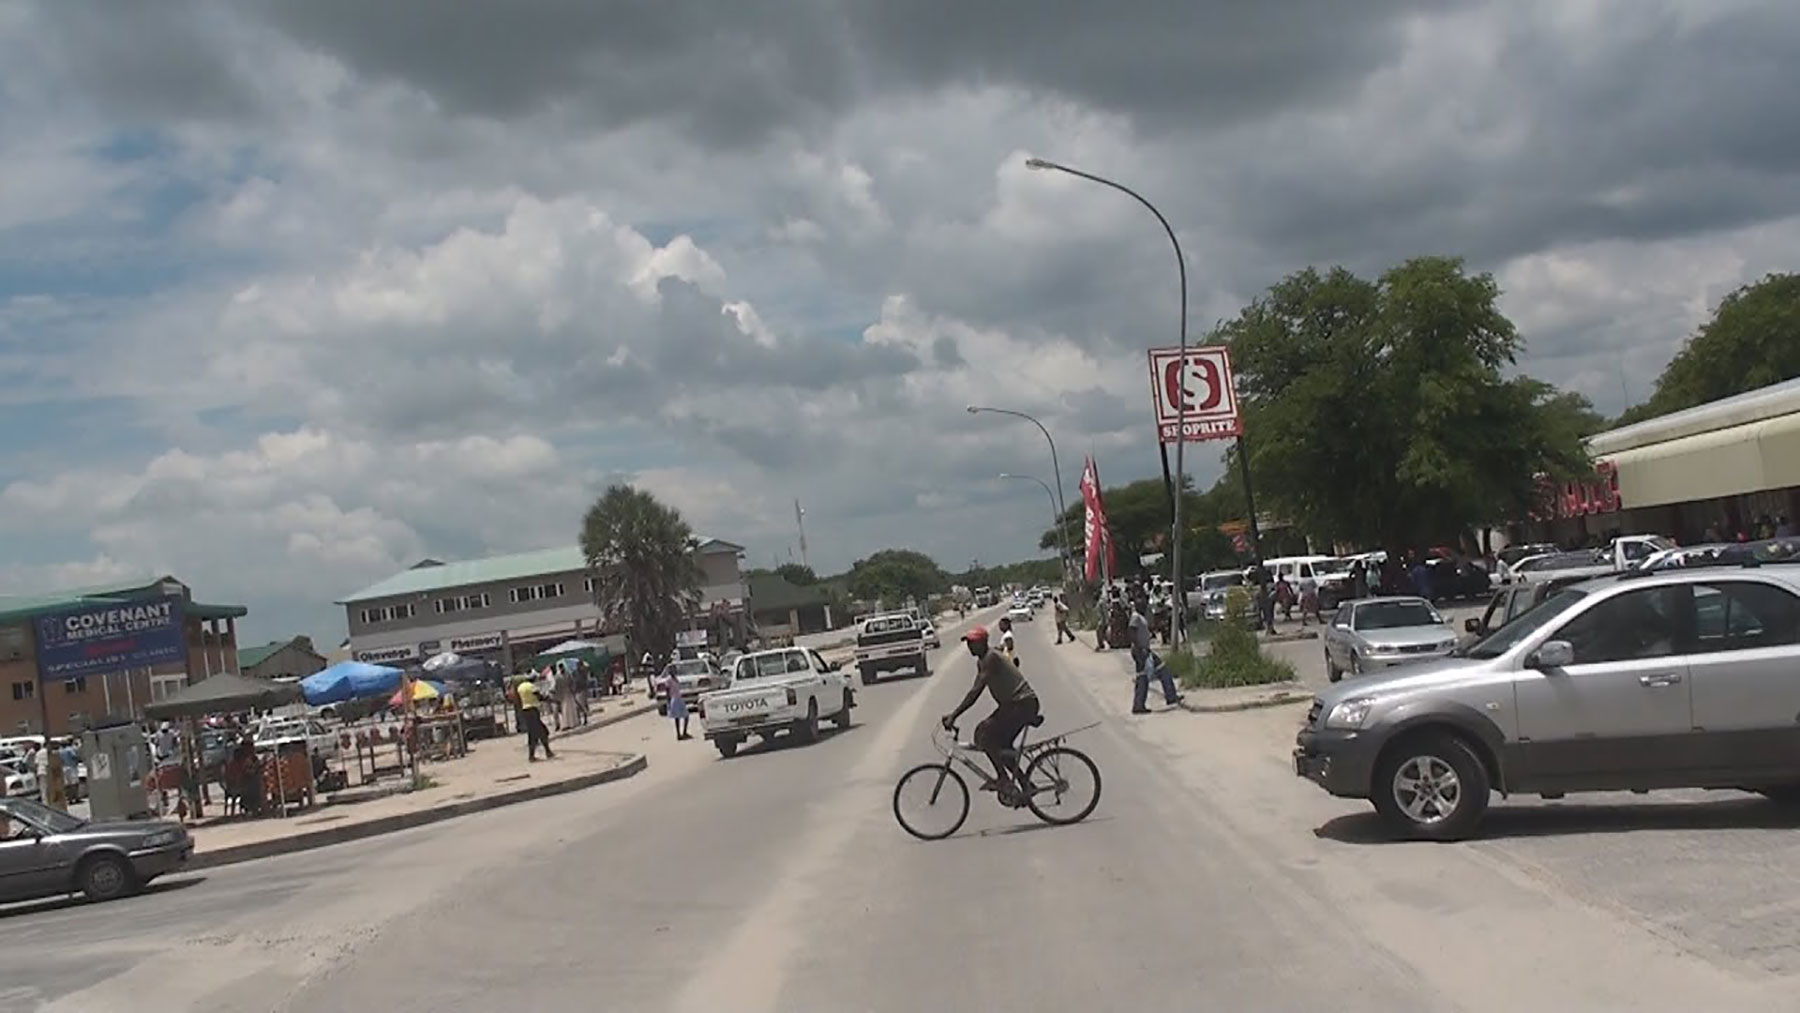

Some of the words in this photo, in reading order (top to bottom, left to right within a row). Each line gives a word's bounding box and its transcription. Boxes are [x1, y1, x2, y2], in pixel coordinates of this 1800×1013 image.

[65, 602, 171, 631] COVENANT
[66, 622, 121, 639] MEDICAL
[125, 617, 170, 631] CENTRE
[451, 636, 500, 649] Pharmacy
[48, 655, 126, 672] SPECIALIST
[724, 698, 768, 712] TOYOTA
